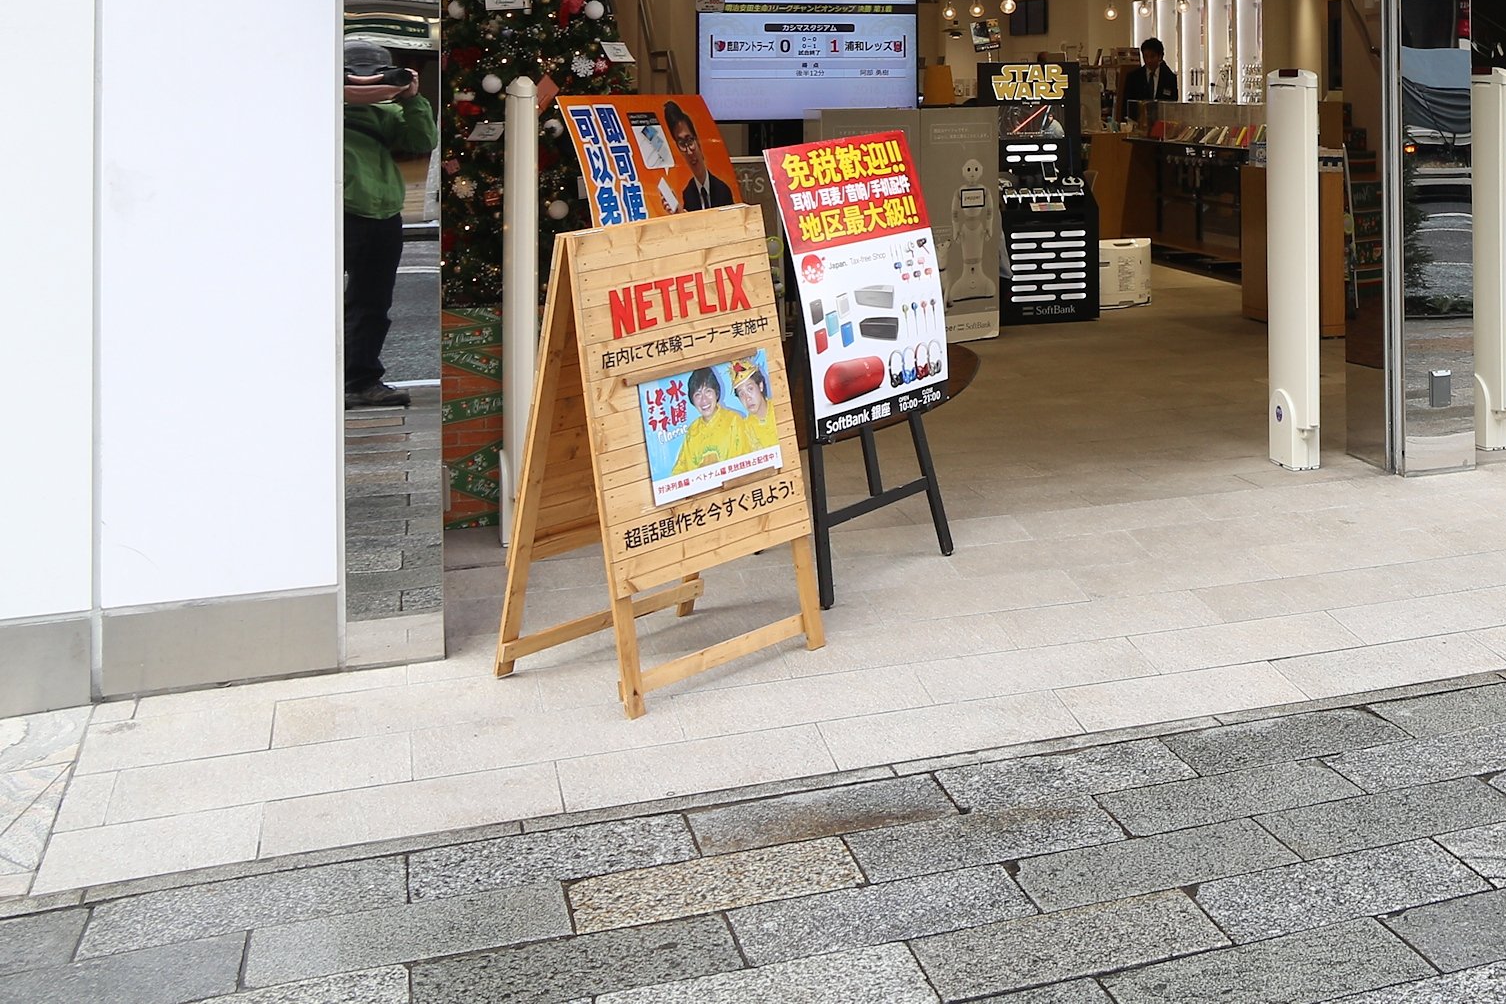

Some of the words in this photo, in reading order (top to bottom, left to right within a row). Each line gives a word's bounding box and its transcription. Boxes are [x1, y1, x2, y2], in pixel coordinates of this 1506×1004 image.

[781, 24, 838, 32] カシマスタジアム
[780, 39, 791, 53] 0
[830, 39, 840, 53] 1
[844, 40, 893, 52] 浦和レッズ
[991, 64, 1069, 83] STAR
[991, 82, 1069, 101] WARS
[781, 140, 906, 191] 免税歓迎!!
[798, 195, 920, 244] 地区最大級!!
[608, 263, 752, 340] NETFLIX
[1036, 304, 1076, 316] SoftBank
[965, 320, 991, 330] SoftBank
[601, 315, 769, 370] 店内にて体験コーナー実施中
[898, 394, 910, 404] OPEN
[825, 408, 871, 435] SoftBank
[871, 401, 892, 421] 銀座
[624, 480, 795, 551] 超話題作を今すぐ見よう!
